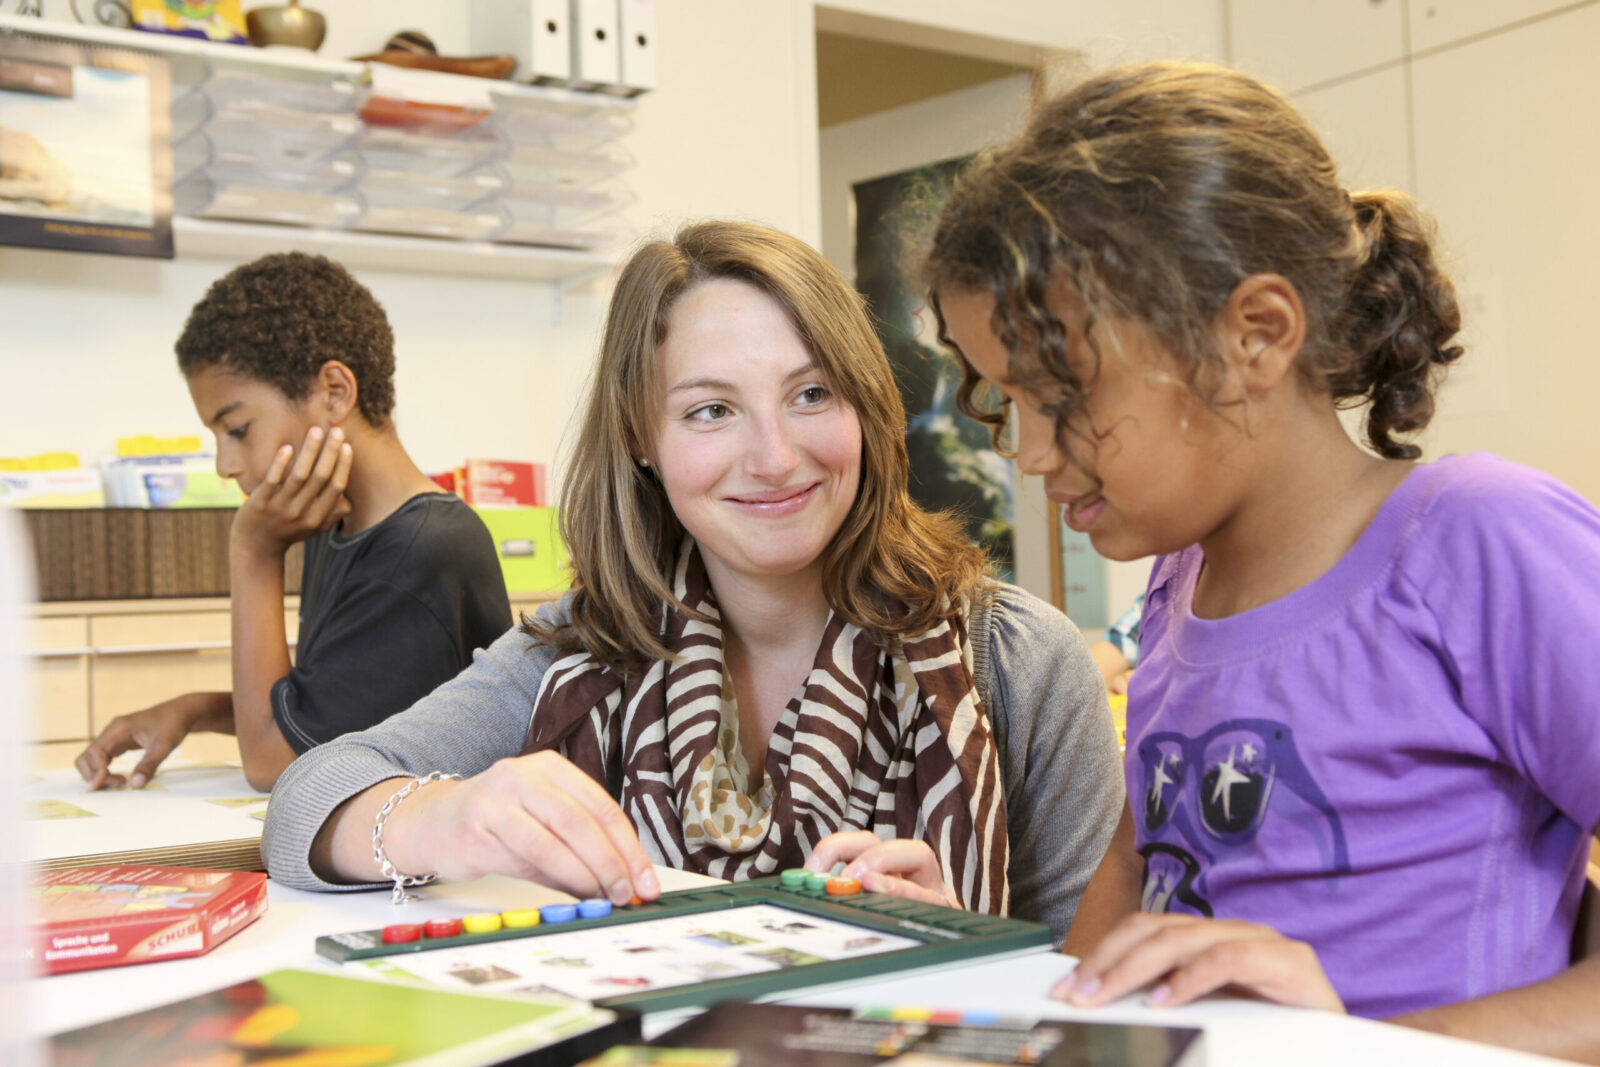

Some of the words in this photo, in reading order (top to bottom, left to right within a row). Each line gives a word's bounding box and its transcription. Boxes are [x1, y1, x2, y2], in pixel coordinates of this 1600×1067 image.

[53, 935, 89, 949] Sprache
[90, 931, 110, 944] und
[45, 944, 118, 961] Kommunikation
